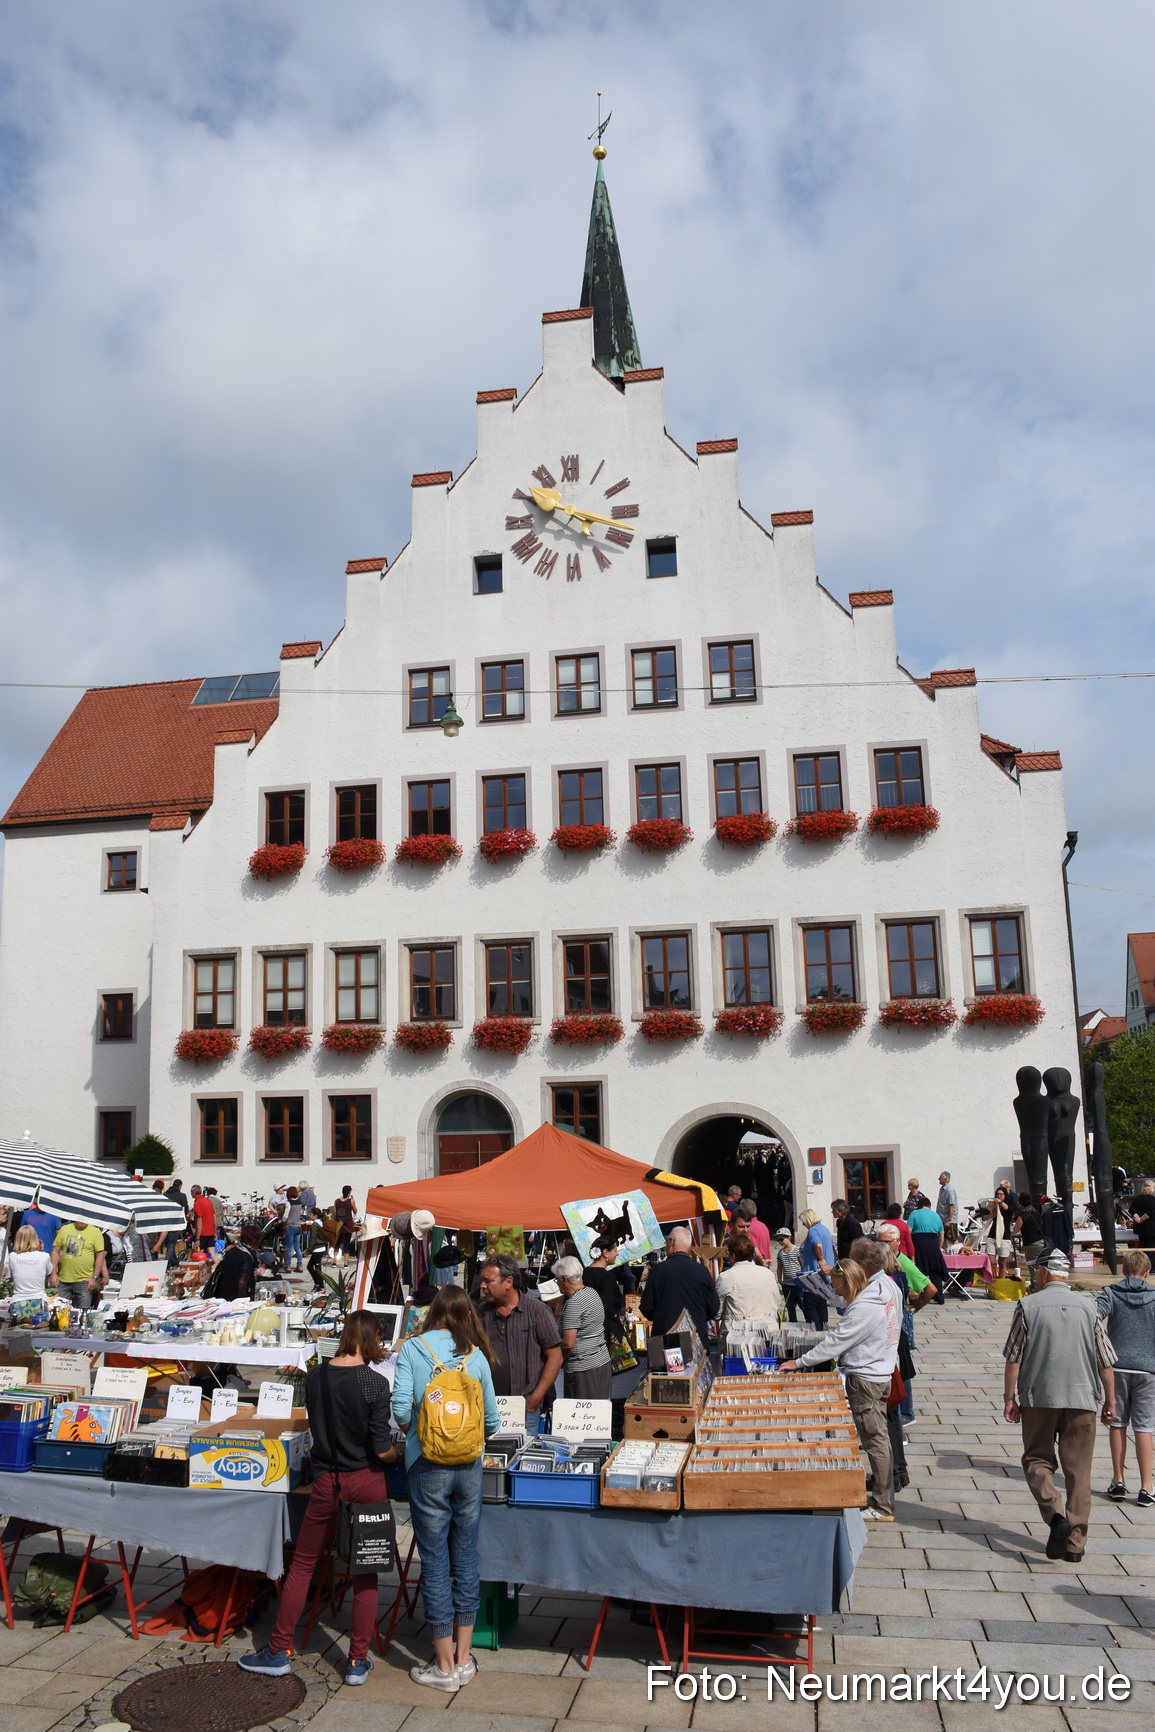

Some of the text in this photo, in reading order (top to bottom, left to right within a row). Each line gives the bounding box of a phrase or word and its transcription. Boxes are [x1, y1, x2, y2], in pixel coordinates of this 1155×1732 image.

[560, 454, 580, 482] XII
[589, 459, 605, 485] I
[603, 477, 631, 499] II
[610, 504, 640, 519] III
[505, 513, 534, 531] IX
[510, 530, 543, 565] VIII
[533, 548, 559, 580] VII
[592, 545, 612, 573] V
[566, 553, 582, 582] VI
[175, 1387, 192, 1395] Singles
[217, 1390, 234, 1398] Singles
[268, 1384, 286, 1393] Singles
[276, 1394, 288, 1402] Euro
[497, 1398, 508, 1406] VD
[575, 1401, 592, 1409] DVD
[556, 1422, 562, 1430] 3
[191, 1437, 259, 1447] PREMIUM BANANAS
[217, 1457, 261, 1480] derby
[359, 1513, 390, 1523] BERLIN
